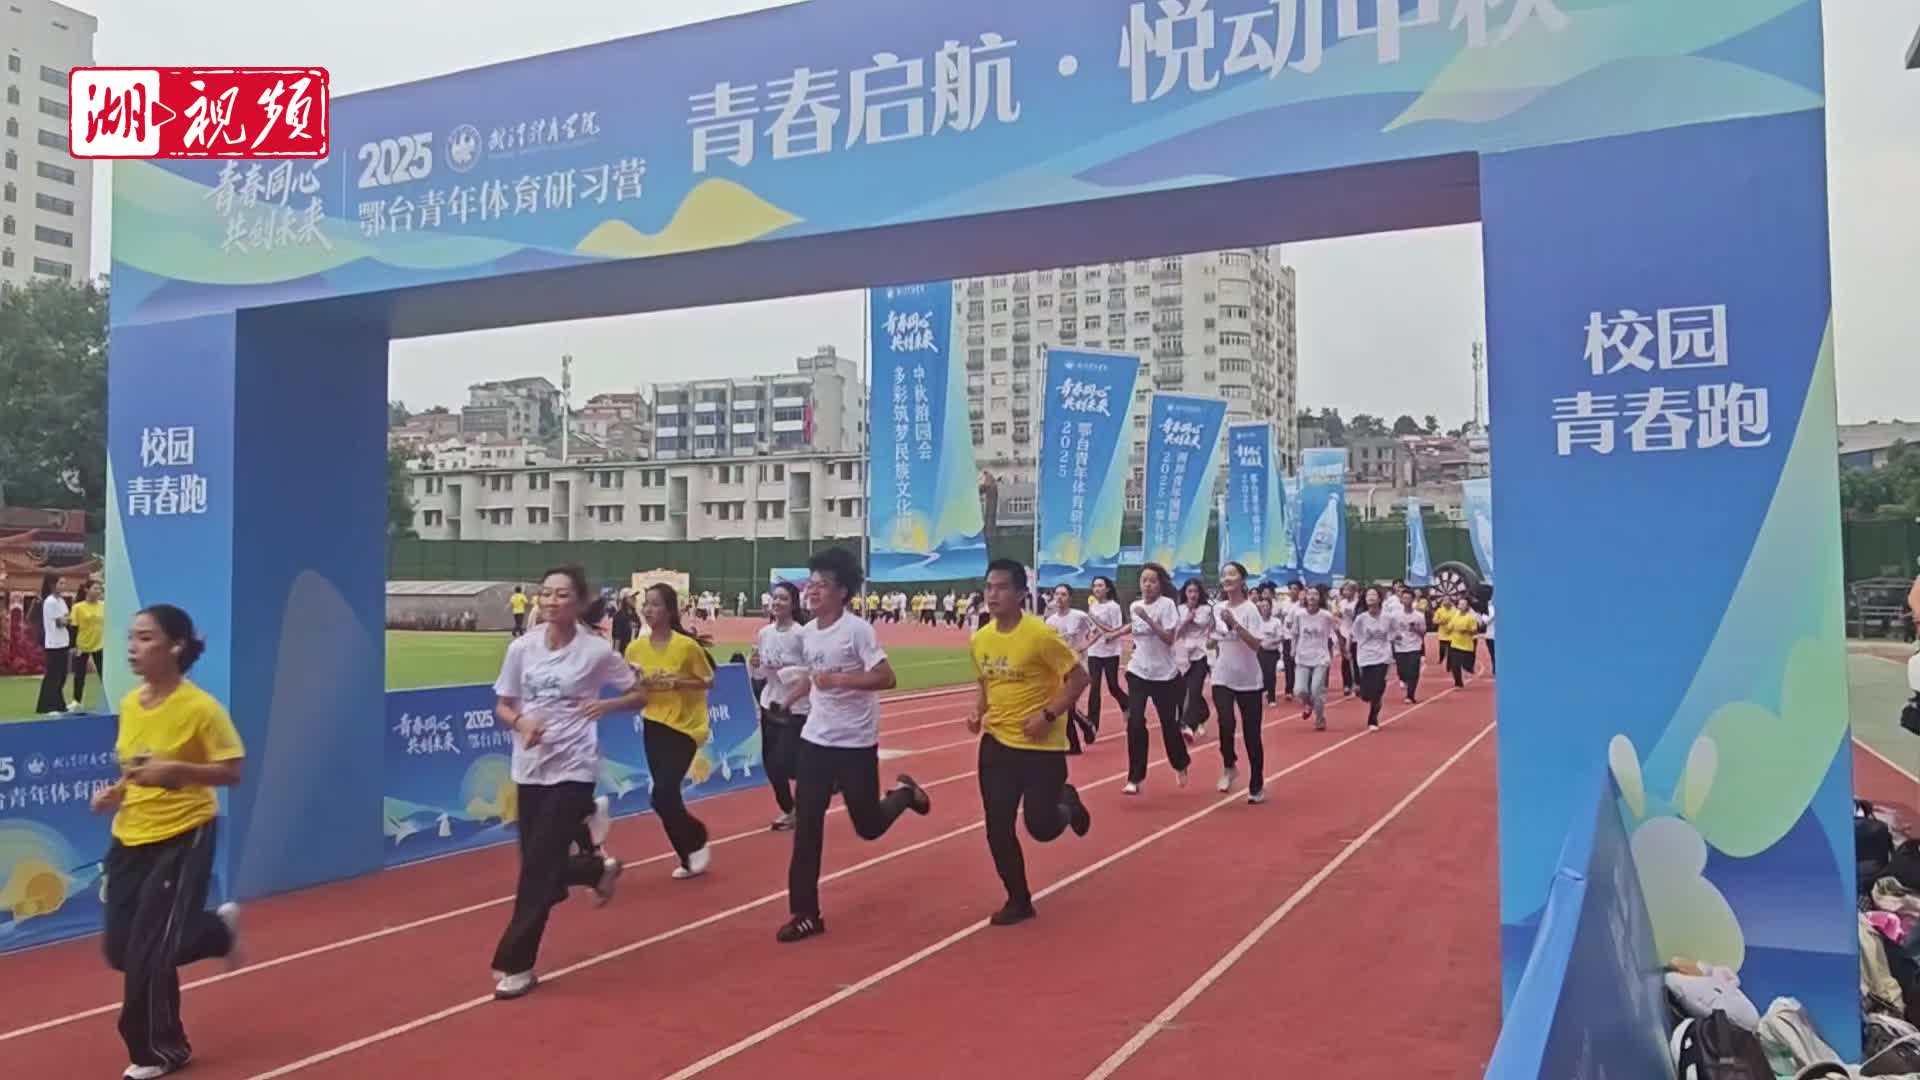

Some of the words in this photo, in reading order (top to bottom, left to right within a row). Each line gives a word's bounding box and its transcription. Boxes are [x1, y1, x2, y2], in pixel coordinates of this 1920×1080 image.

[358, 132, 433, 189] 2025
[358, 157, 647, 238] 鄂台青年体育研习营
[1583, 304, 1728, 375] 校园
[140, 426, 194, 467] 校园
[1552, 382, 1771, 456] 青春跑
[1057, 420, 1072, 478] 2025
[127, 473, 208, 516] 青春跑
[464, 710, 495, 729] 2025
